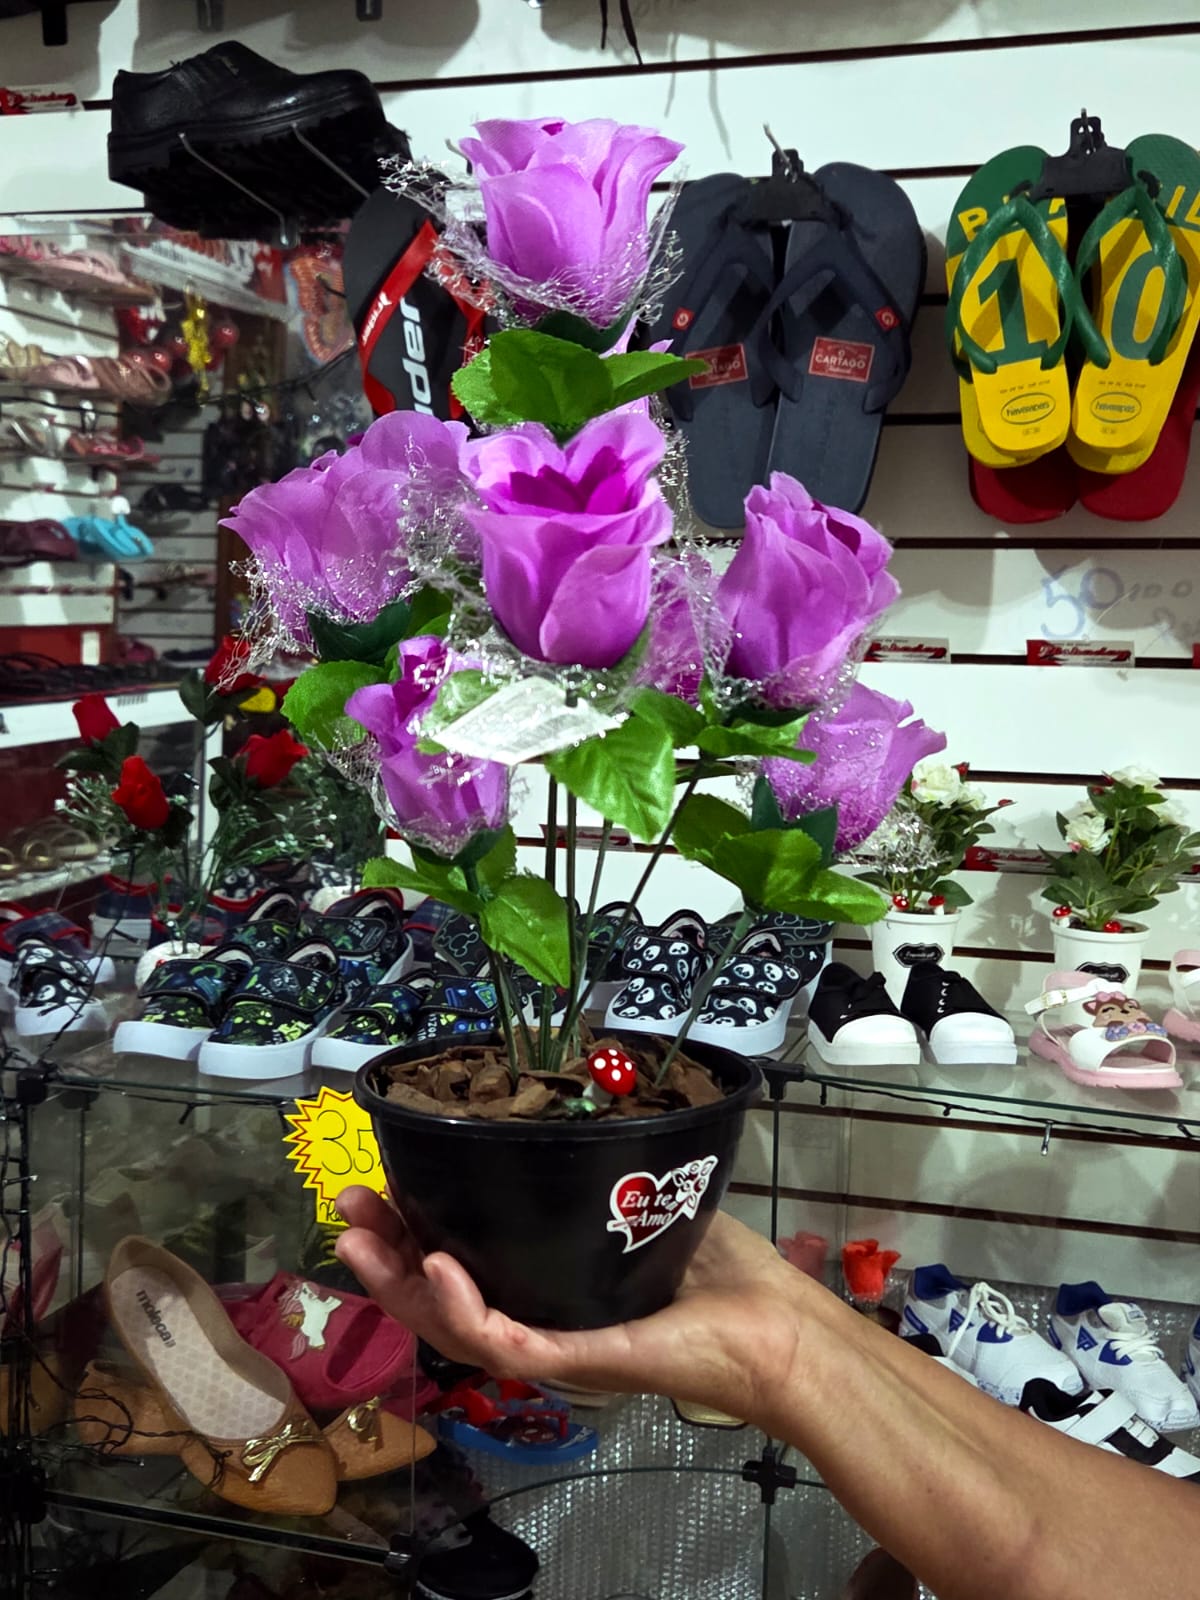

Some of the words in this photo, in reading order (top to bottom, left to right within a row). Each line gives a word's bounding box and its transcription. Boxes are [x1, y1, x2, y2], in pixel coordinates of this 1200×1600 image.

[400, 295, 434, 416] ider
[620, 1190, 651, 1209] Eu
[653, 1193, 673, 1207] te
